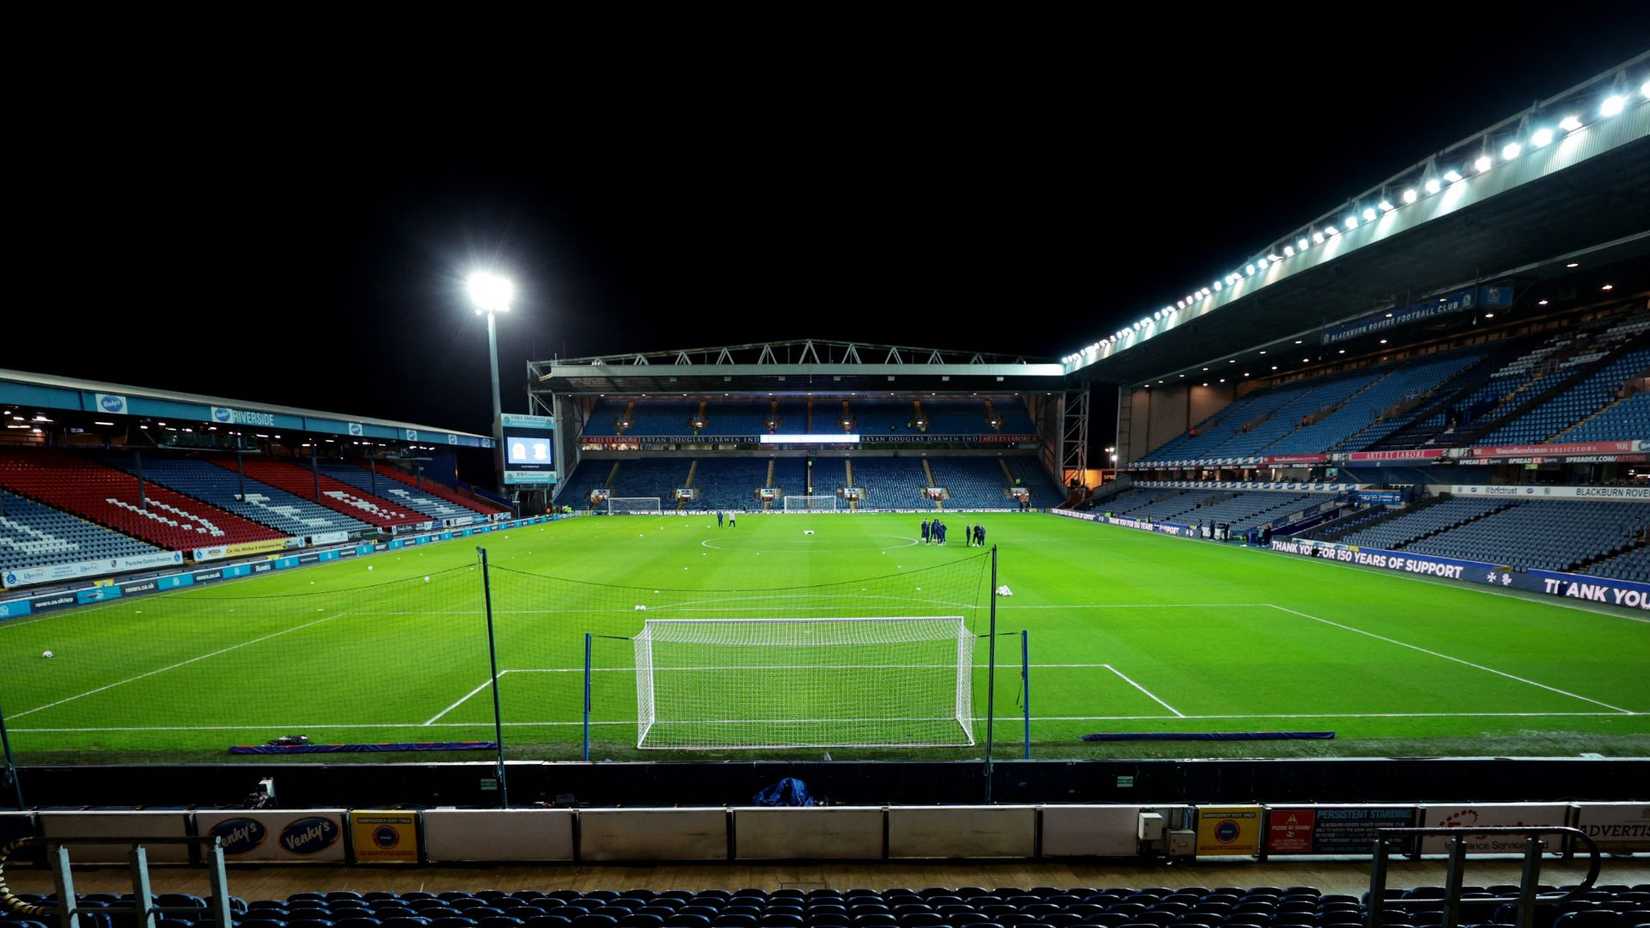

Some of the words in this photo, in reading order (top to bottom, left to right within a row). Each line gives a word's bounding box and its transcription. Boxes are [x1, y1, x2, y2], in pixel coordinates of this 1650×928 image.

[1397, 309, 1435, 324] FOOTBALL
[1437, 301, 1459, 314] CLUB
[232, 409, 275, 426] RIVERSIDE
[1576, 487, 1623, 497] BLACKBURN
[1272, 540, 1298, 554] THANK
[1337, 550, 1352, 562] 150
[1354, 552, 1386, 568] YEARS
[1388, 557, 1403, 570] OF
[1406, 559, 1464, 579] SUPPORT
[1317, 808, 1367, 819] PERSISTENT
[221, 822, 257, 847] enky's
[286, 821, 330, 849] Venky's
